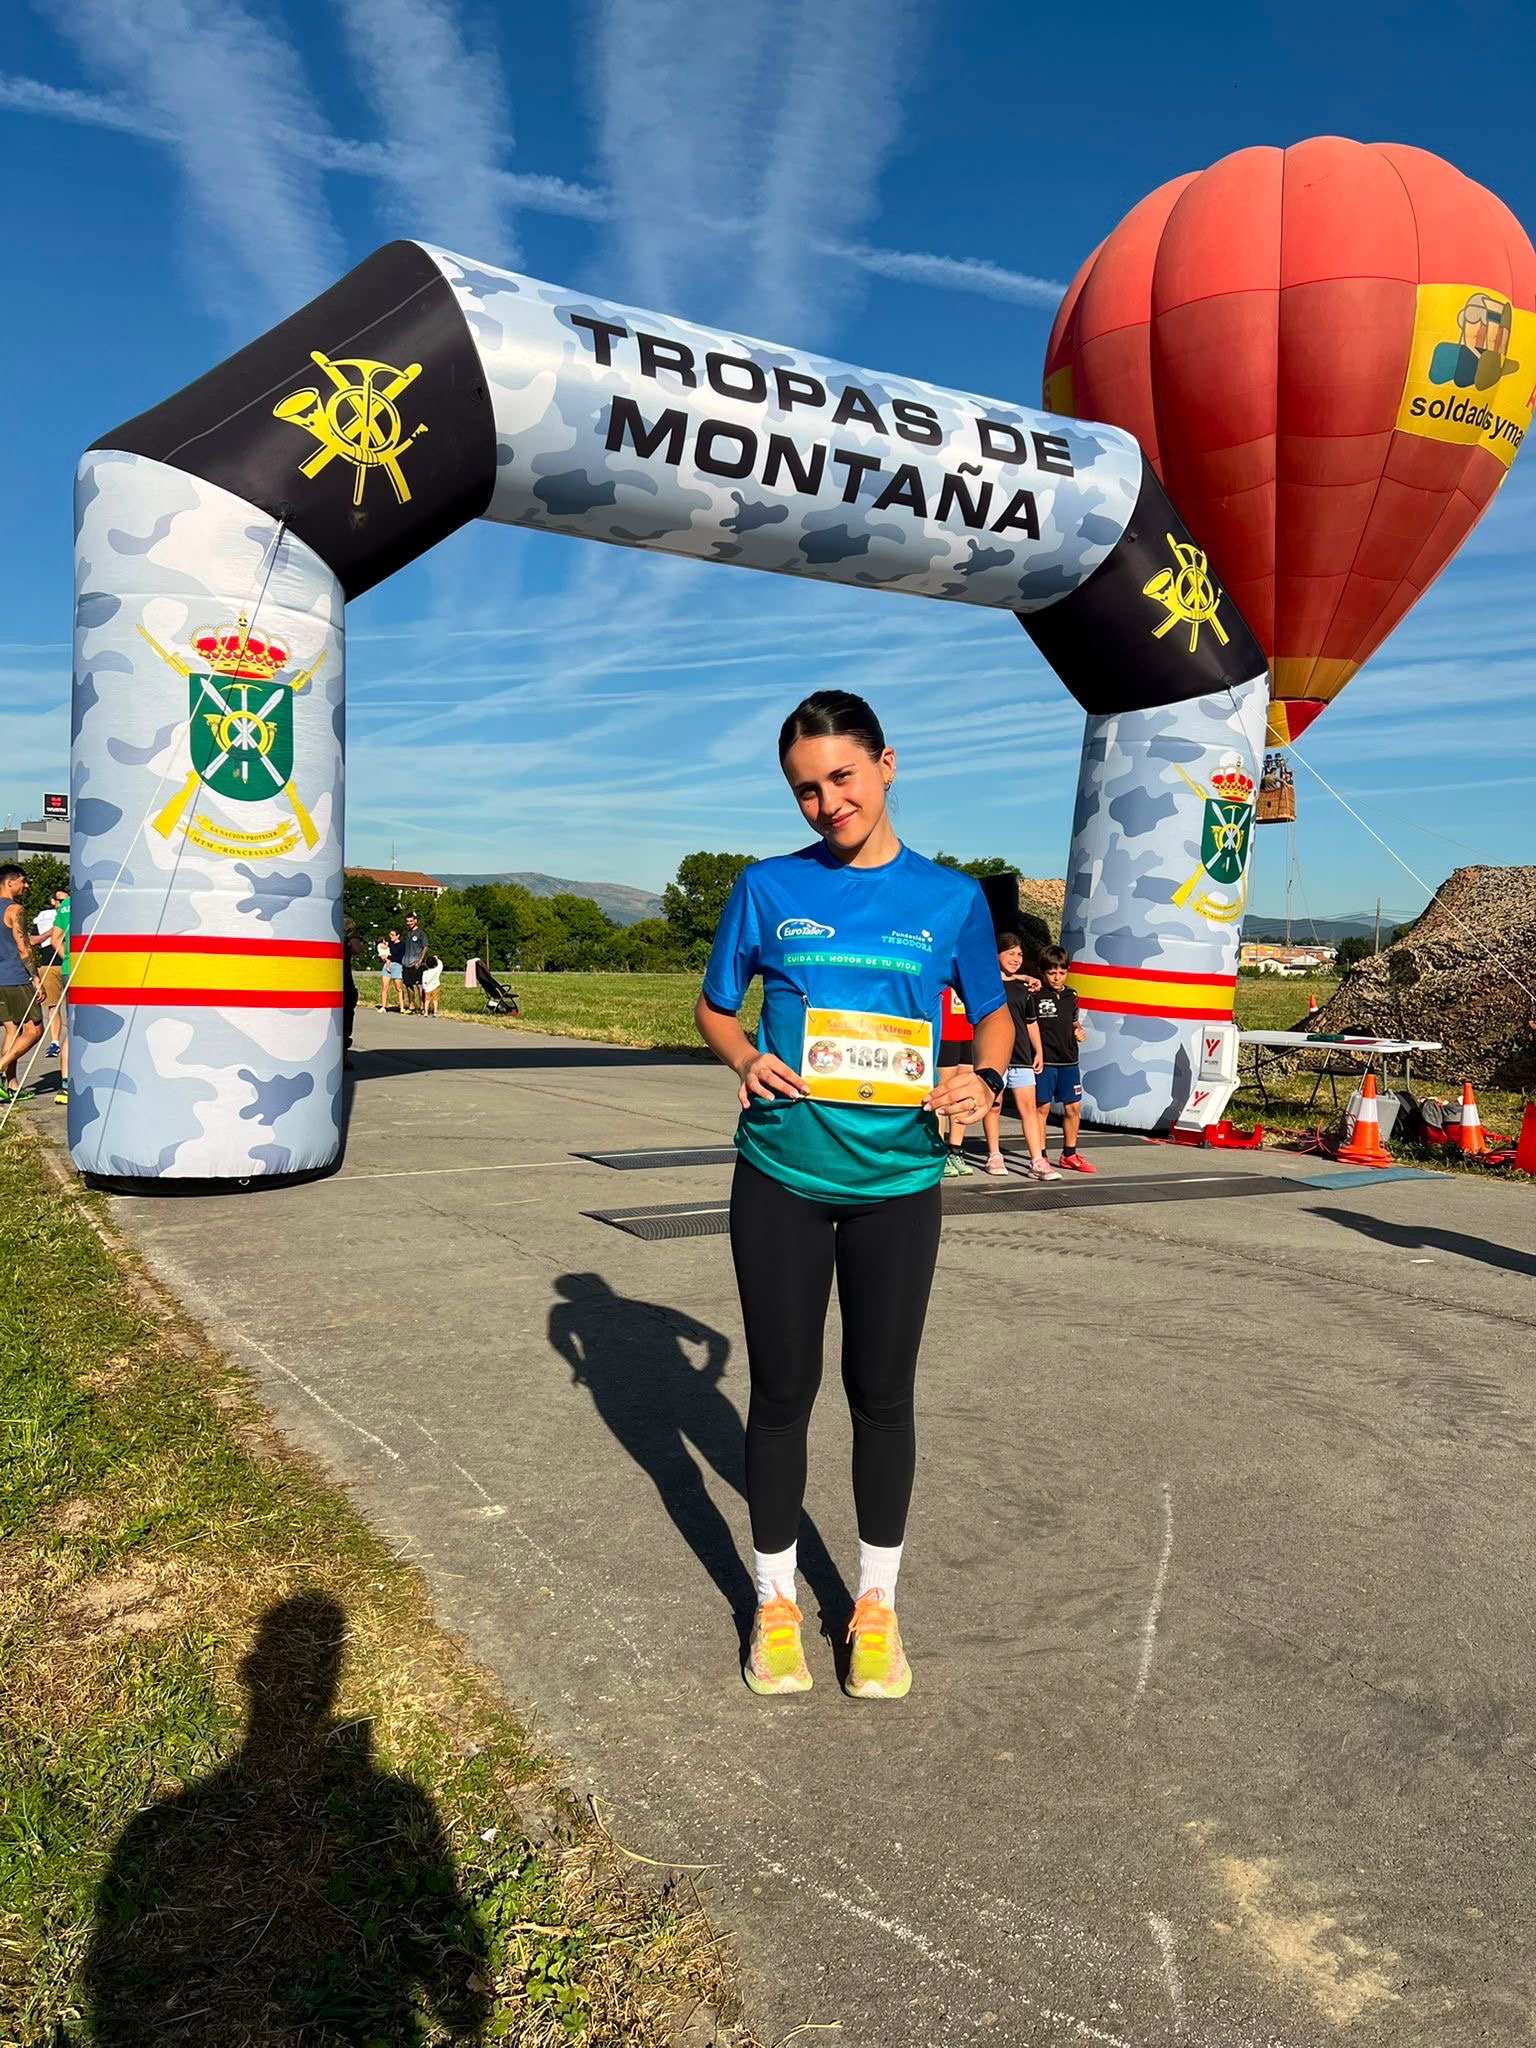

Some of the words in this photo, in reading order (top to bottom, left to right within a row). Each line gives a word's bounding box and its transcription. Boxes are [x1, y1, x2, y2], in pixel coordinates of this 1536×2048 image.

[570, 314, 943, 447] TROPAS
[975, 418, 1075, 477] DE
[604, 395, 1041, 540] MONTAÑA
[246, 831, 277, 841] PROTEGER
[784, 927, 826, 937] EuroTaller
[891, 930, 926, 942] Fundación
[881, 935, 932, 952] THEODORA
[787, 955, 812, 963] CUIDA
[829, 955, 862, 964] MOTOR
[896, 961, 917, 971] VIDA
[846, 1046, 889, 1071] 189
